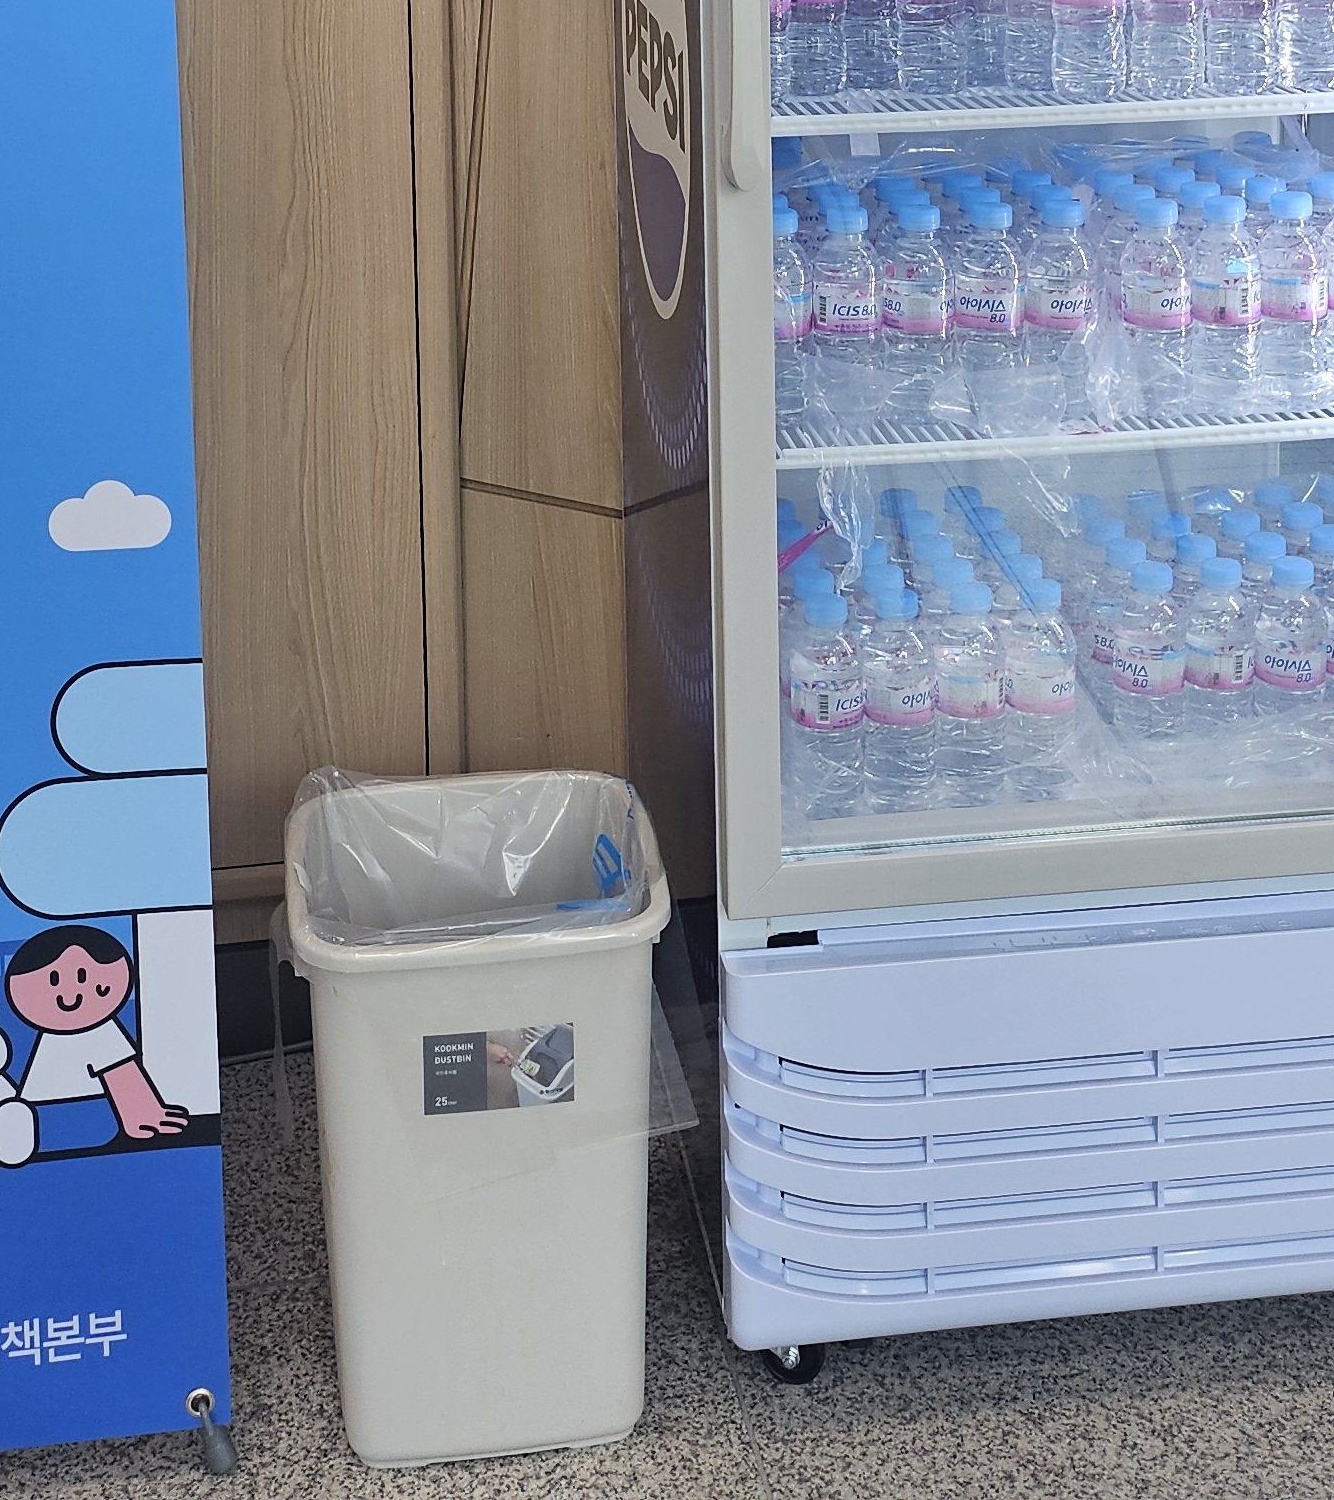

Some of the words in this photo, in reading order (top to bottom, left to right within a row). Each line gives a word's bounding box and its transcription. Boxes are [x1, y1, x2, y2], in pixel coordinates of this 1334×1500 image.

[959, 296, 1006, 312] 아이시스
[832, 303, 860, 317] ICIS
[989, 314, 1006, 323] 8.0
[1264, 655, 1311, 672] 아이시스
[1132, 677, 1148, 688] 8.0
[434, 1043, 474, 1052] KOOKMIN
[434, 1054, 472, 1064] DUSTBIN
[435, 1096, 447, 1106] 25
